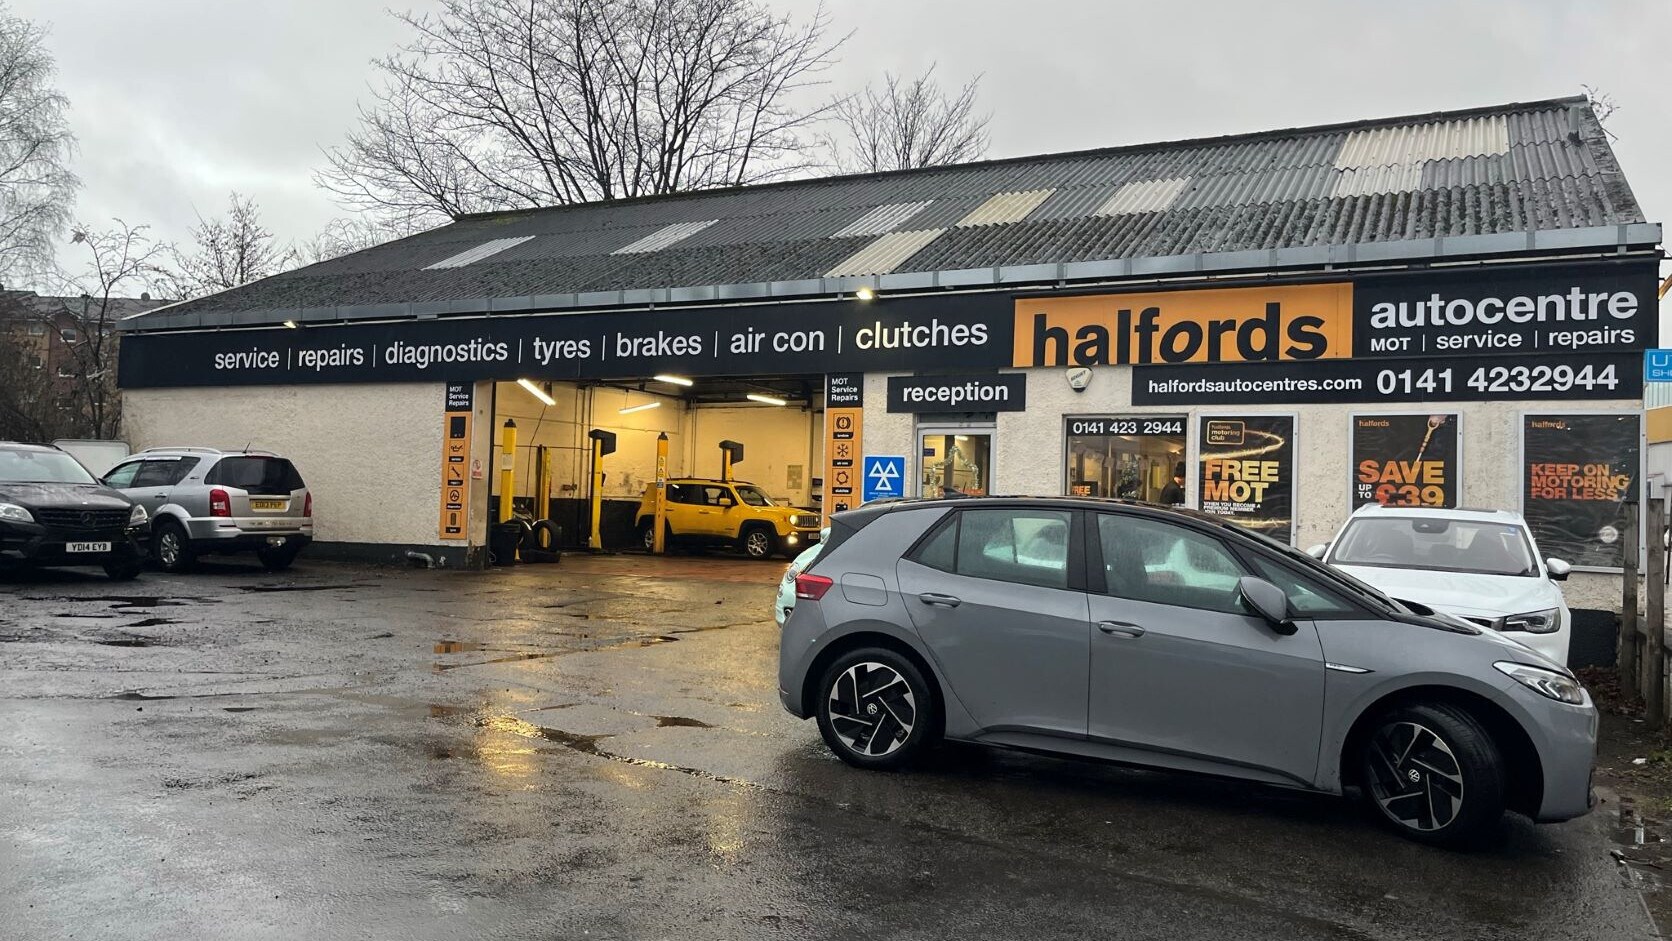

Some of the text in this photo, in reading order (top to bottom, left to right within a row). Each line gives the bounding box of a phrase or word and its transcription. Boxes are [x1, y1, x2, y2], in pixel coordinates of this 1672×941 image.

[1370, 287, 1638, 329] autocentre
[214, 319, 988, 372] service repairs diagnostics tyres brakes air con clutches
[1033, 302, 1328, 366] halfords
[1370, 326, 1636, 351] MOT service repairs
[1652, 354, 1672, 367] U
[1148, 364, 1619, 394] halfordsautocentres.com 0141 4232944
[1652, 369, 1672, 377] SH
[831, 394, 858, 402] Repairs
[903, 382, 1008, 405] reception
[1073, 421, 1182, 433] 0141 423 2944
[1205, 460, 1279, 481] FREE
[1358, 460, 1444, 483] SAVE
[1531, 464, 1610, 476] KEEP ON
[1204, 480, 1269, 503] MOT
[1531, 475, 1630, 489] MOTORING
[1375, 484, 1444, 507] £39
[1531, 488, 1618, 500] FOR LESS
